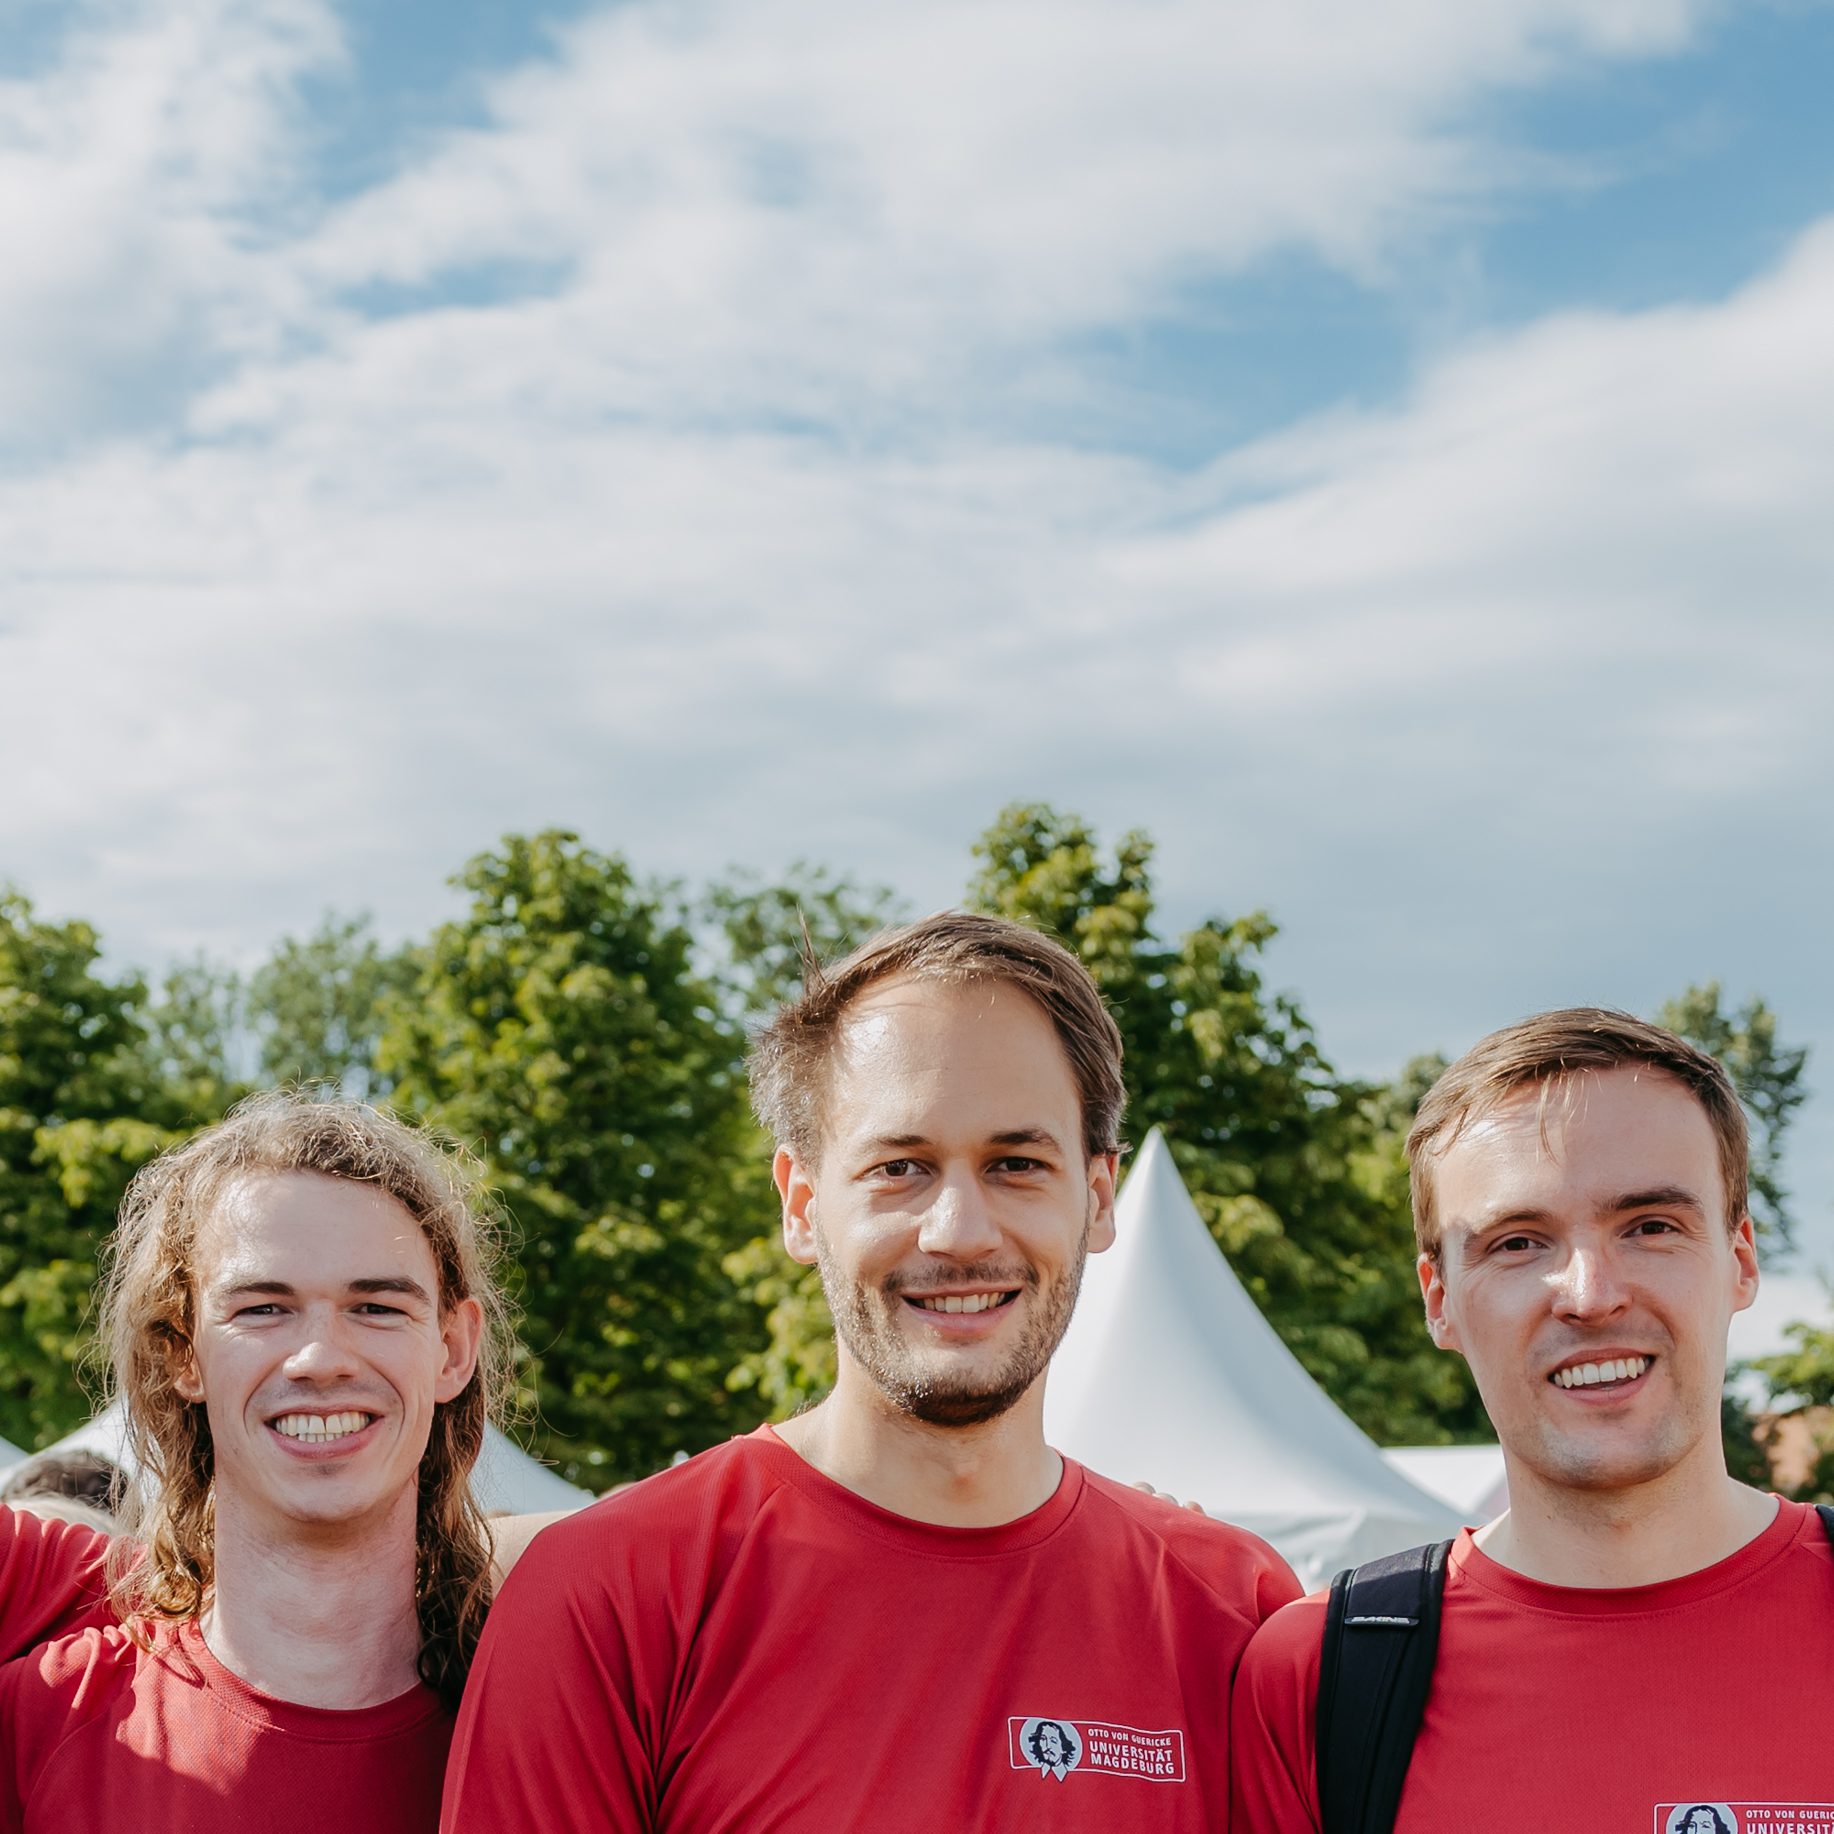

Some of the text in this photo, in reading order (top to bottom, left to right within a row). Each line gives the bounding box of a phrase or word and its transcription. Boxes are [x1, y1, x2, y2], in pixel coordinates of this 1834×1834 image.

[1087, 1728, 1172, 1746] OTTO VON GUERICKE
[1089, 1741, 1173, 1762] UNIVERSITÄT
[1090, 1753, 1175, 1775] MAGDEBURG
[1746, 1809, 1771, 1819] OTTO
[1775, 1809, 1795, 1819] VON
